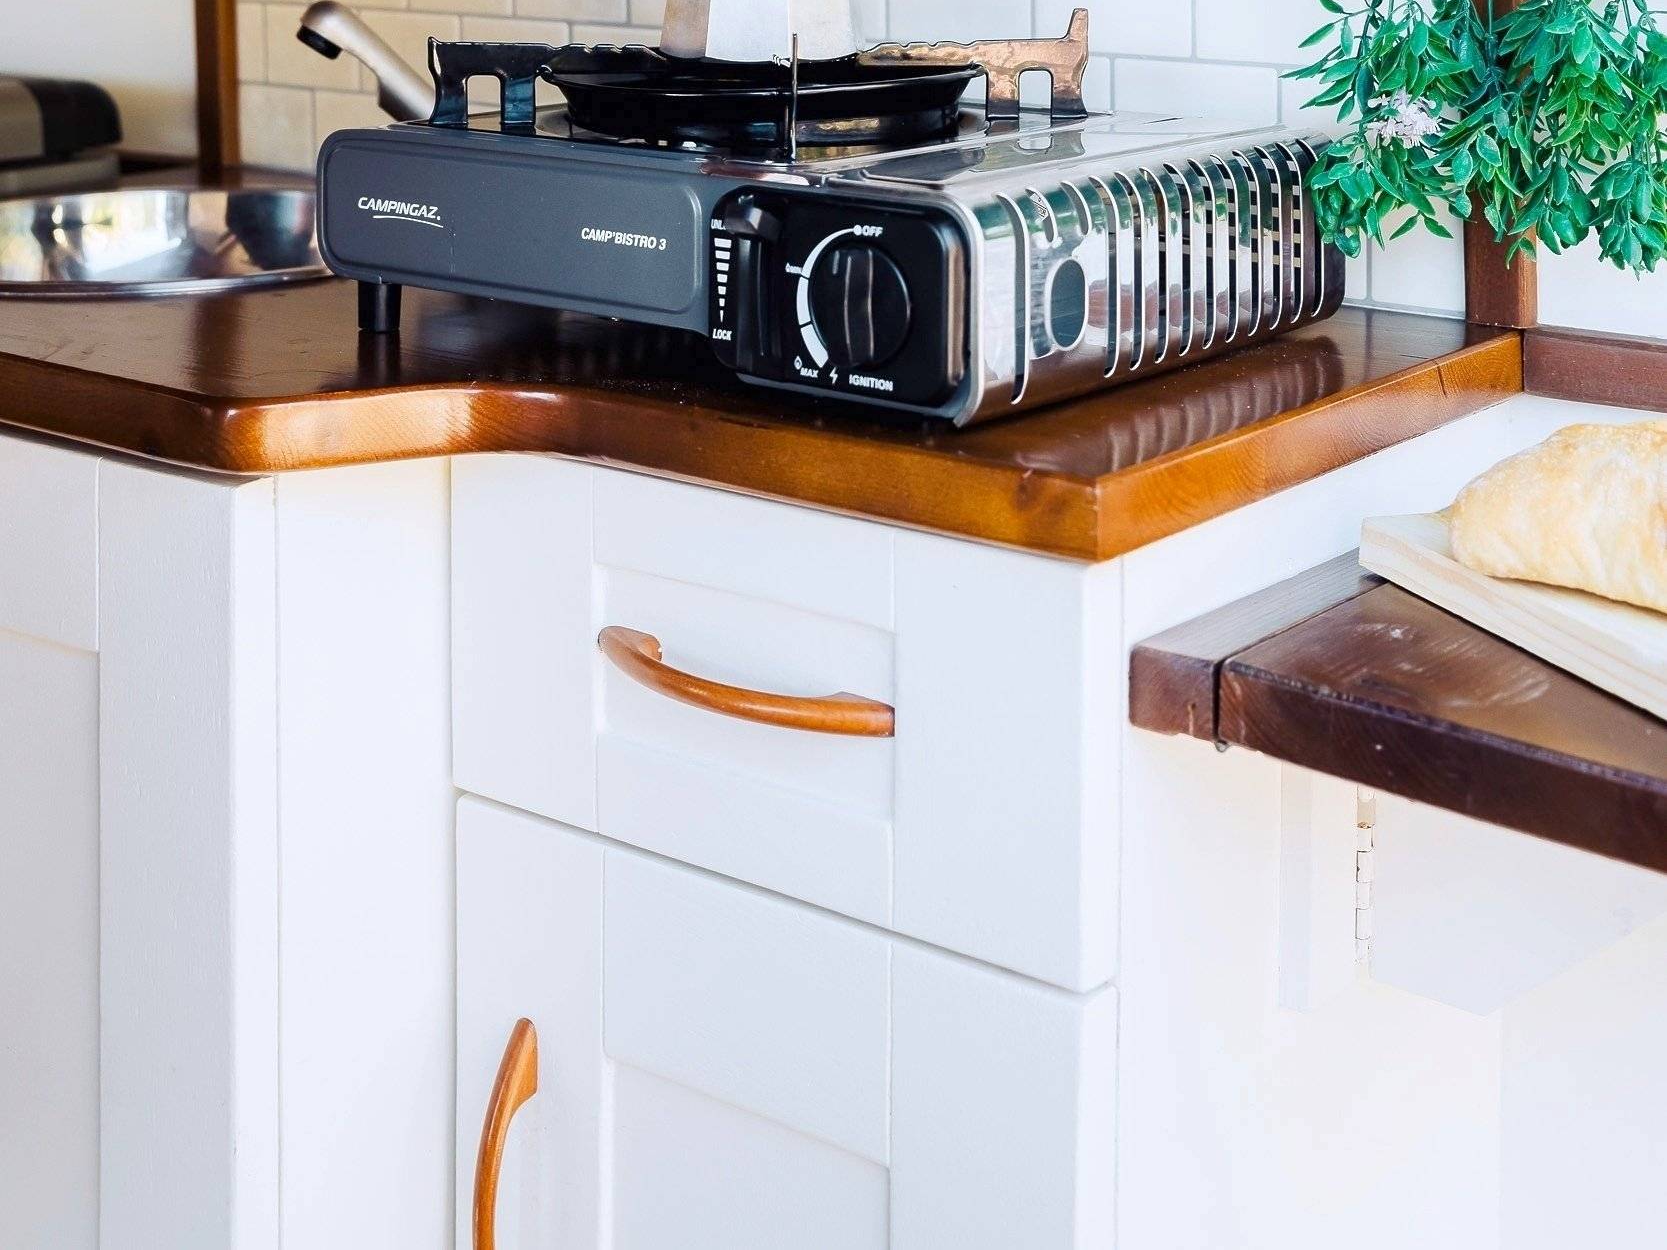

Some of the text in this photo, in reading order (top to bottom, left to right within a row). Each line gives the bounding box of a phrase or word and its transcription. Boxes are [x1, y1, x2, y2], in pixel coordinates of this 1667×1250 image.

[358, 197, 439, 219] CAMPINGAZ
[581, 227, 667, 251] CAMP'BISTRO 3
[863, 226, 883, 238] OFF
[713, 329, 732, 342] LOCK
[800, 367, 818, 378] MAX
[849, 374, 893, 391] IGNITION
